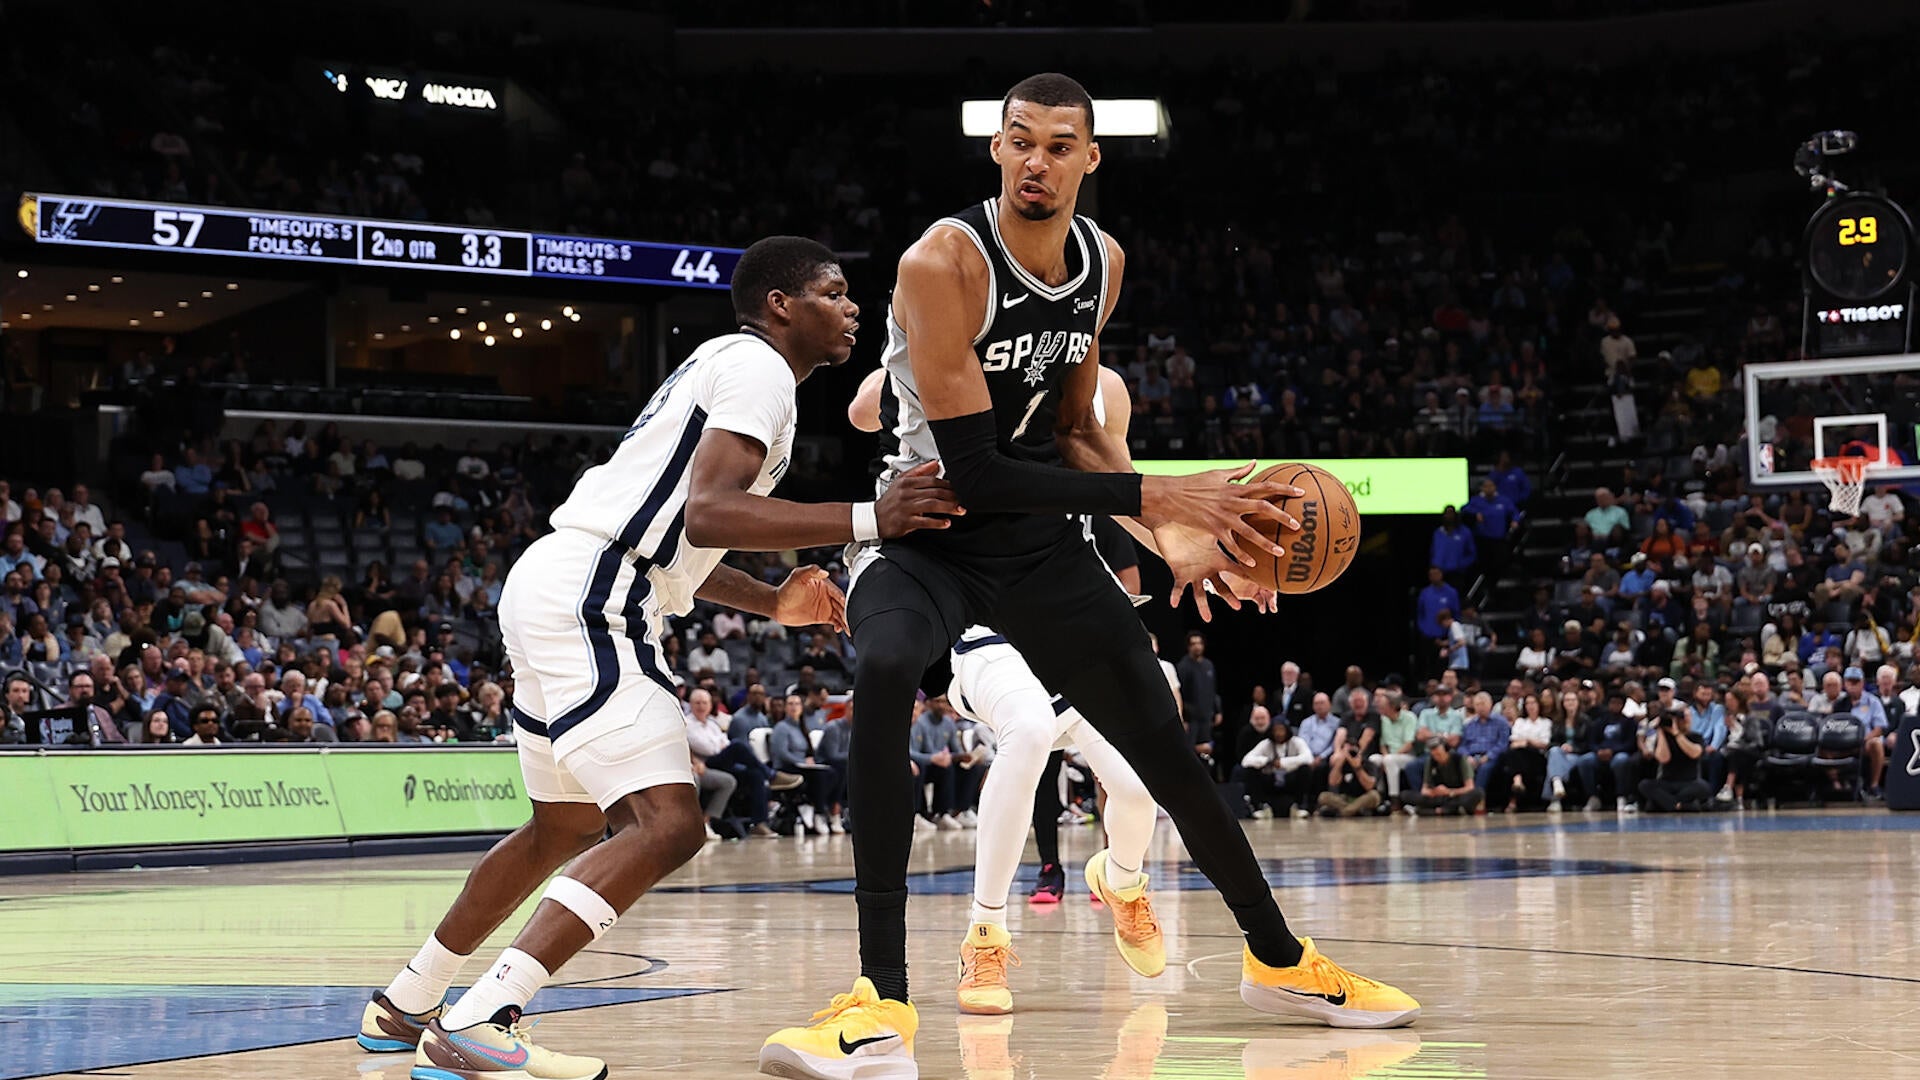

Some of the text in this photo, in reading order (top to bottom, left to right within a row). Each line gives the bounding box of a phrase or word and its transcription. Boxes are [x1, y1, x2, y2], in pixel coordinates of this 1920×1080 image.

[152, 210, 204, 247] 57
[371, 230, 404, 256] 2ND
[1838, 216, 1878, 246] 2.9
[461, 233, 501, 268] 3.3
[671, 249, 720, 283] 44
[982, 330, 1093, 373] SPURS
[1009, 389, 1049, 442] 1
[1285, 501, 1317, 583] Wilson
[70, 780, 329, 817] Your Money. Your Move.
[423, 778, 517, 802] Robinhood
